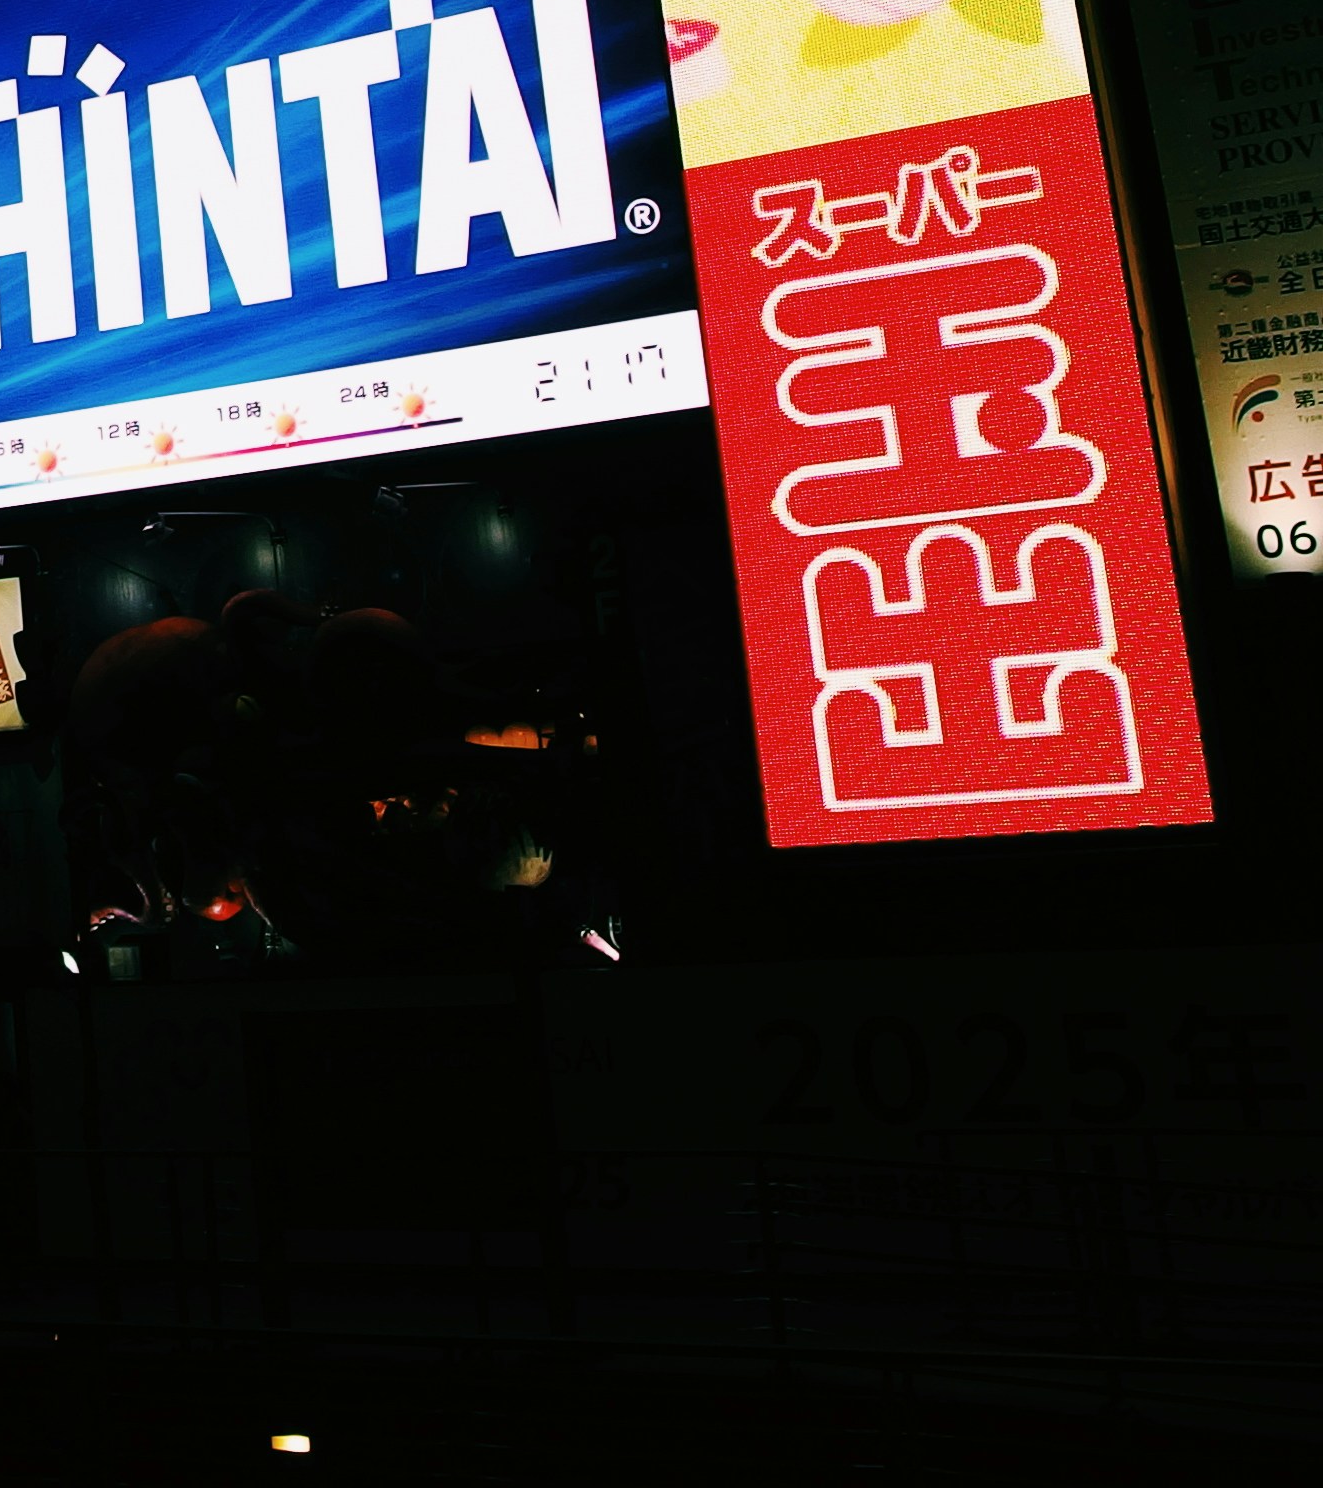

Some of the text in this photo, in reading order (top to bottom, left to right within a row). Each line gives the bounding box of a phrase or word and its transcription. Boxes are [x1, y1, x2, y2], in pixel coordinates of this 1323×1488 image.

[751, 144, 1045, 269] スーパー
[95, 420, 141, 442] 12時
[216, 401, 263, 423] 18時
[339, 380, 390, 404] 24時
[761, 242, 1147, 814] 玉出
